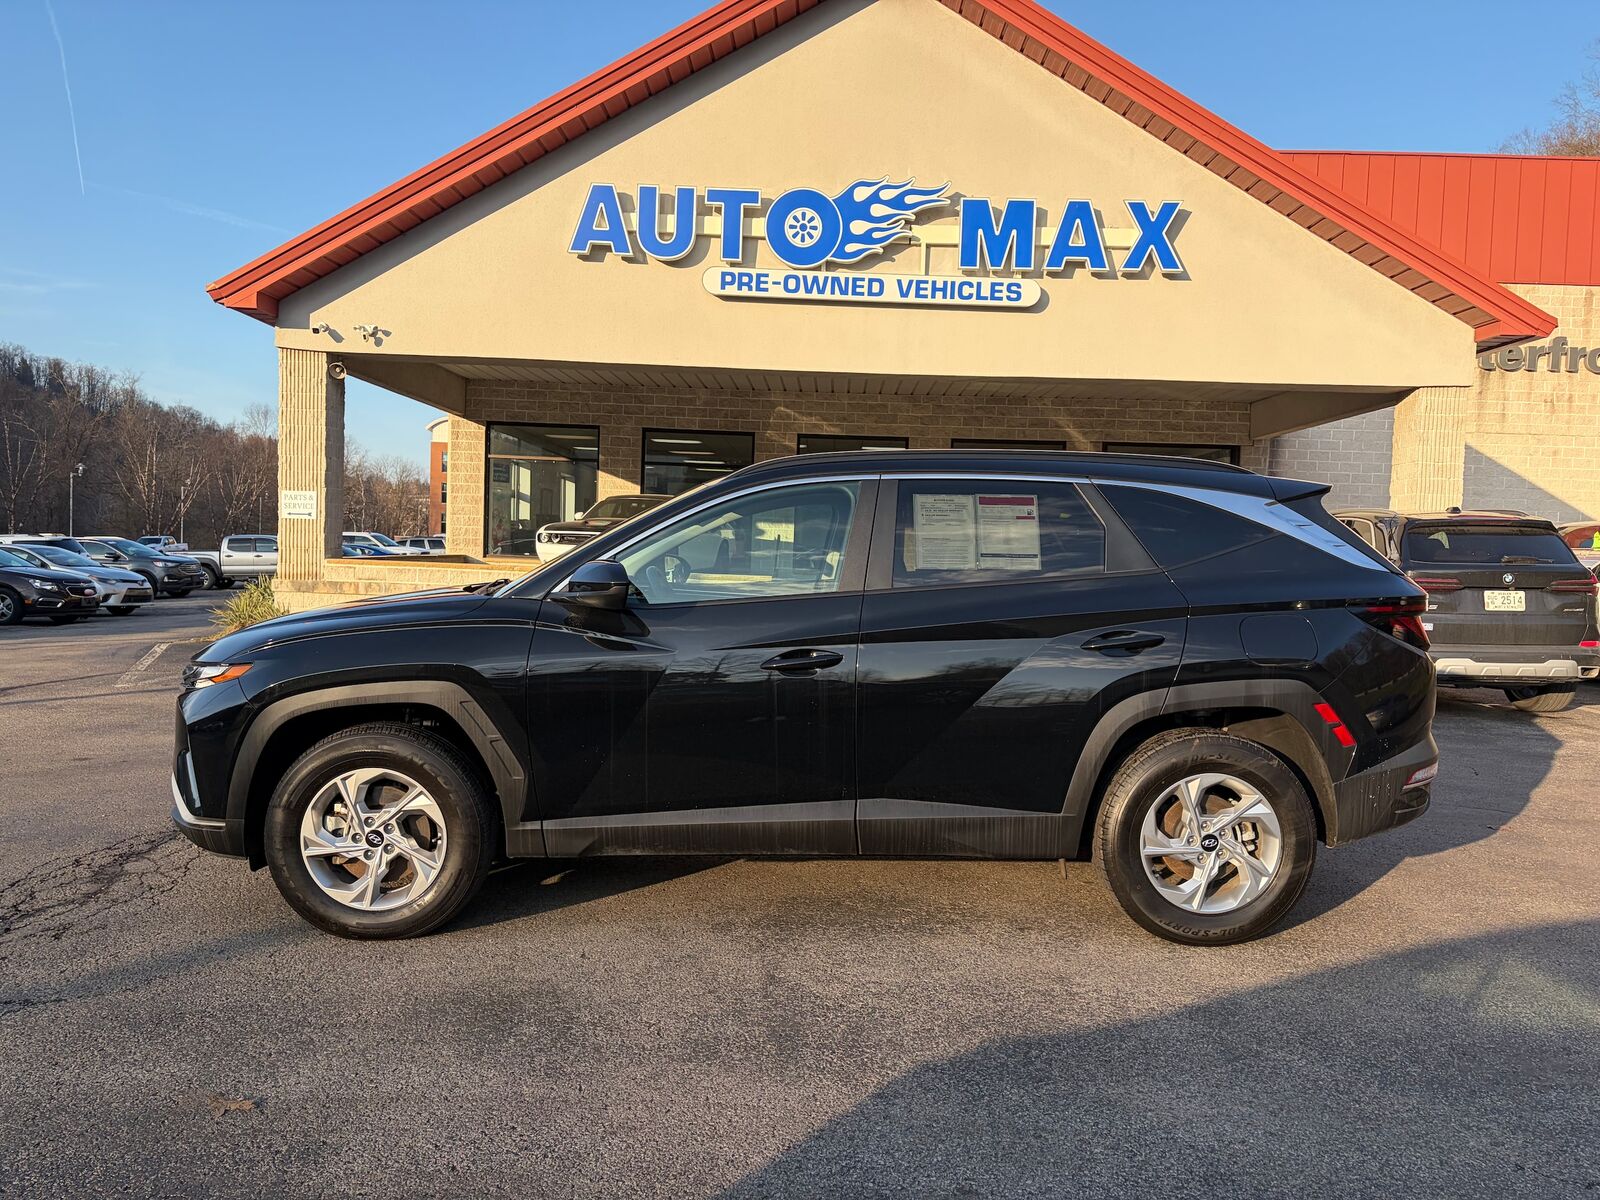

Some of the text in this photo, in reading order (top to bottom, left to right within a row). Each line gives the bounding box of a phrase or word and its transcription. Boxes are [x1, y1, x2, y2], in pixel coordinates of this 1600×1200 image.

[568, 182, 1185, 275] AUTO MAX
[719, 271, 1024, 304] PRE-OWNED VEHICLES
[283, 502, 315, 510] SERVICE
[1501, 595, 1523, 605] 2514
